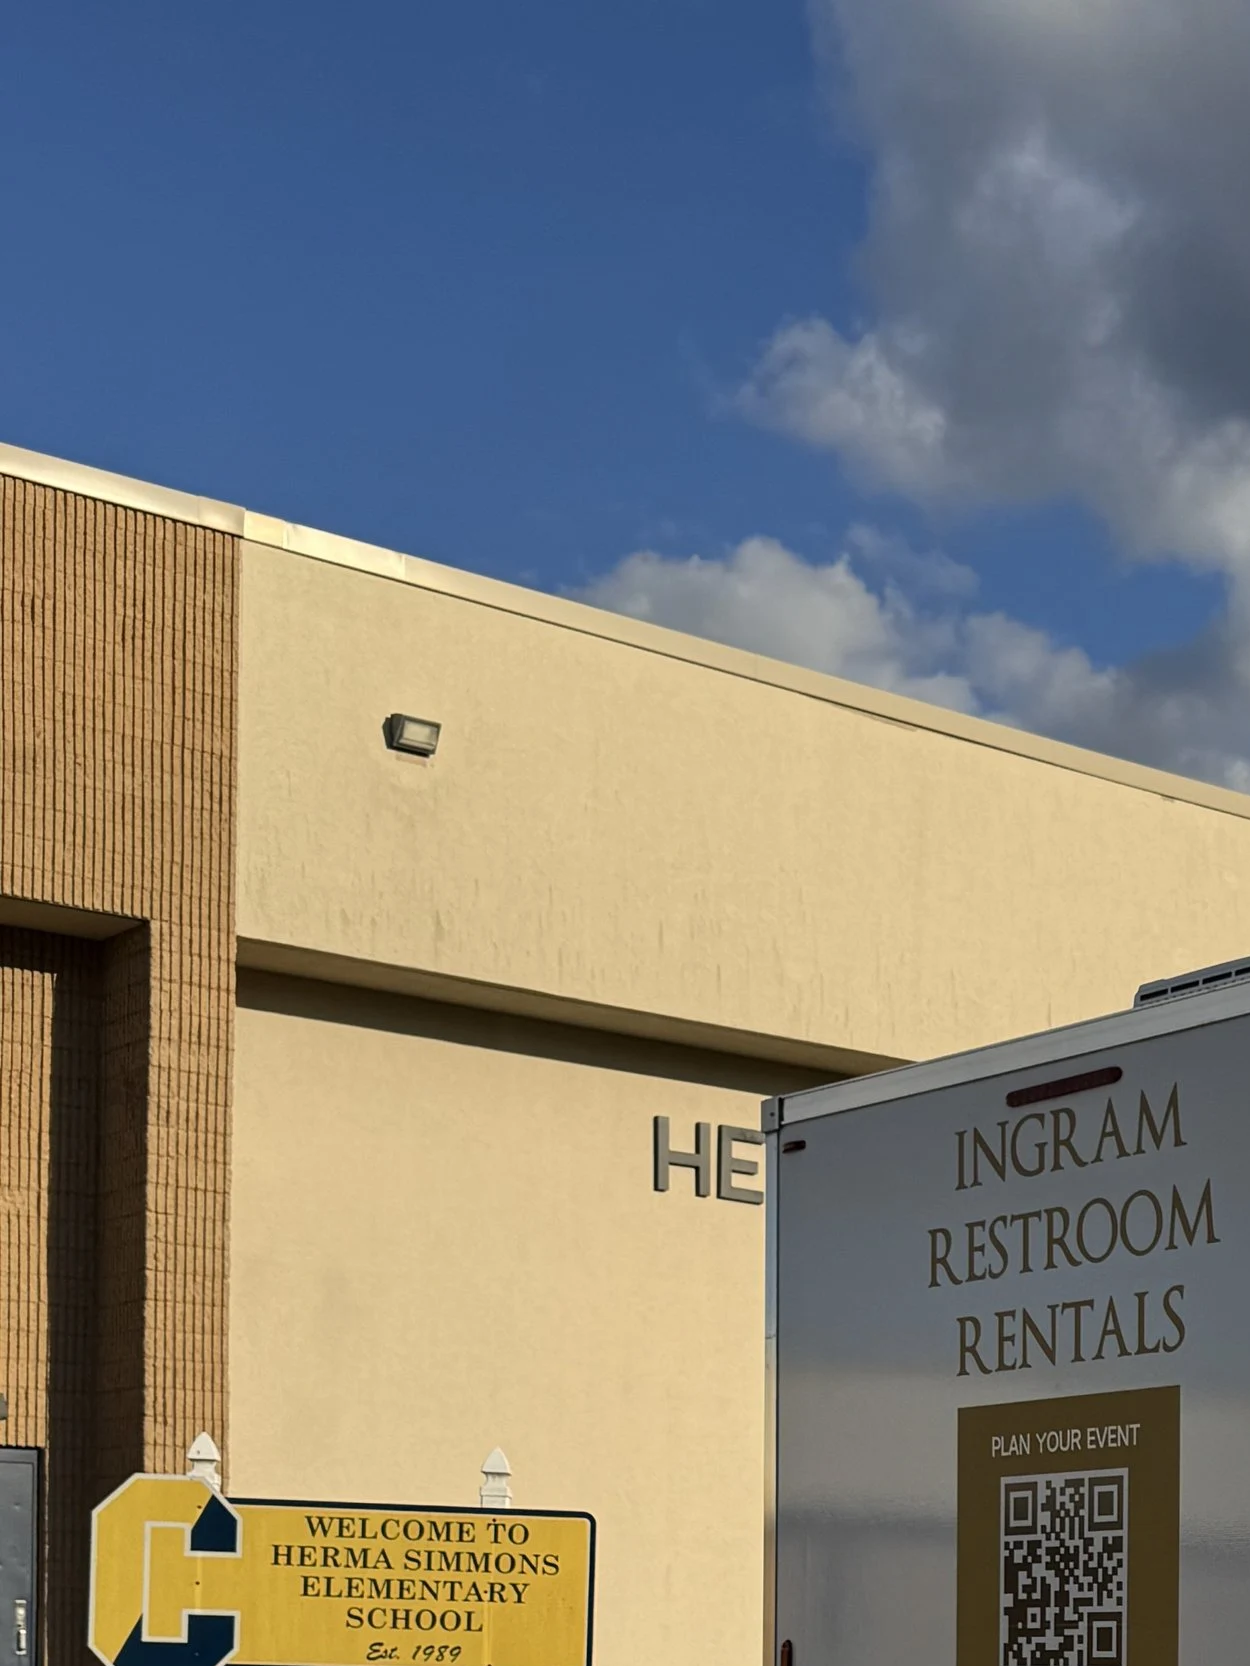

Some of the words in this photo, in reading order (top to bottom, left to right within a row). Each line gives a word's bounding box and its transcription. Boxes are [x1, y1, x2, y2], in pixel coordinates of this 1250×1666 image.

[955, 1081, 1187, 1190] INGRAM
[927, 1177, 1221, 1288] RESTROOM
[956, 1284, 1186, 1376] RENTALS
[991, 1433, 1031, 1458] PLAN
[1036, 1429, 1081, 1453] YOUR
[1087, 1423, 1141, 1449] EVENT
[304, 1516, 475, 1543] WELCOME
[487, 1522, 529, 1545] TO
[271, 1544, 394, 1570] HERMA
[403, 1549, 560, 1576] SIMMONS
[300, 1575, 530, 1604] ELEMENTARY
[345, 1607, 483, 1632] SCHOOL
[366, 1642, 400, 1662] Est.
[412, 1645, 462, 1663] 1989
